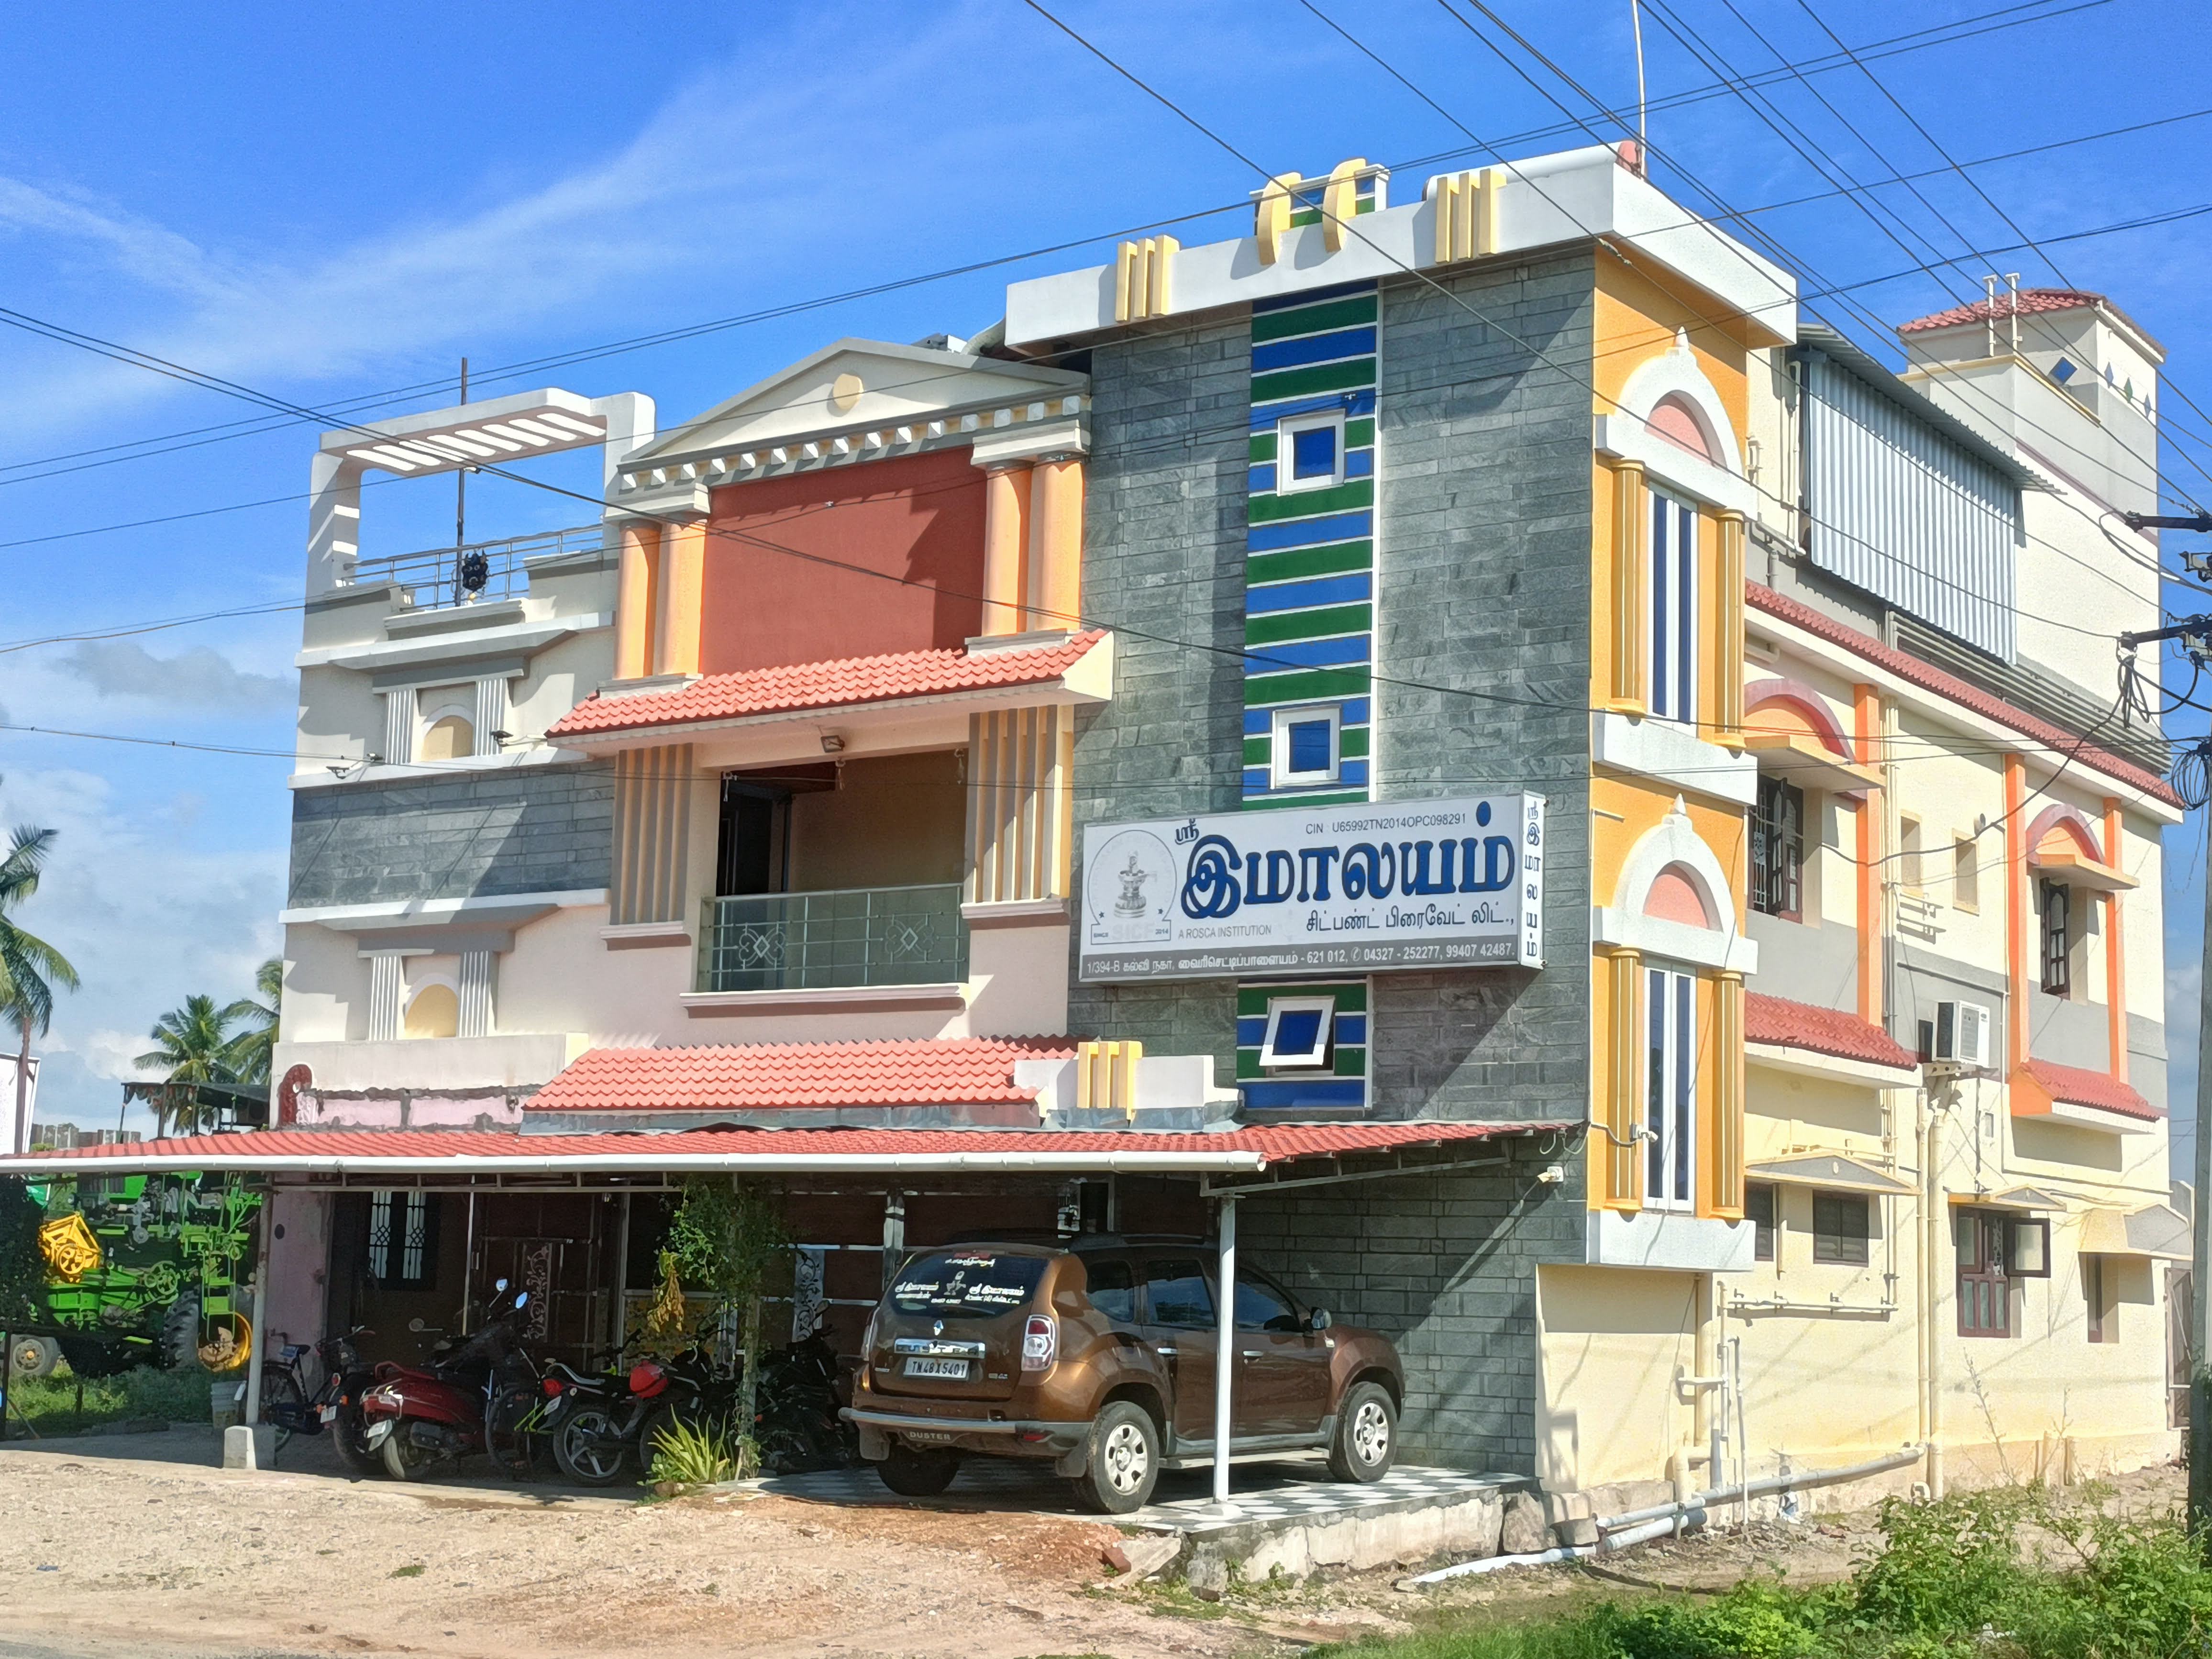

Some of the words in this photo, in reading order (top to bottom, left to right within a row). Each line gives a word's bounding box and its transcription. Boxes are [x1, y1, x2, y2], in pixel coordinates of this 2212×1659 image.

[1305, 822, 1324, 834] CIN
[1181, 800, 1516, 919] இமாலயம்
[1386, 903, 1466, 929] பிரைவேட்
[1178, 930, 1185, 940] A
[1185, 927, 1216, 939] ROSCA
[1217, 924, 1272, 938] INSTITUTION
[1307, 951, 1325, 963] 621
[1327, 949, 1348, 964] 012,
[1364, 948, 1393, 961] 04327
[1403, 946, 1443, 961] 252277,
[1446, 944, 1477, 958] 99407
[909, 1431, 951, 1441] DUSTER
